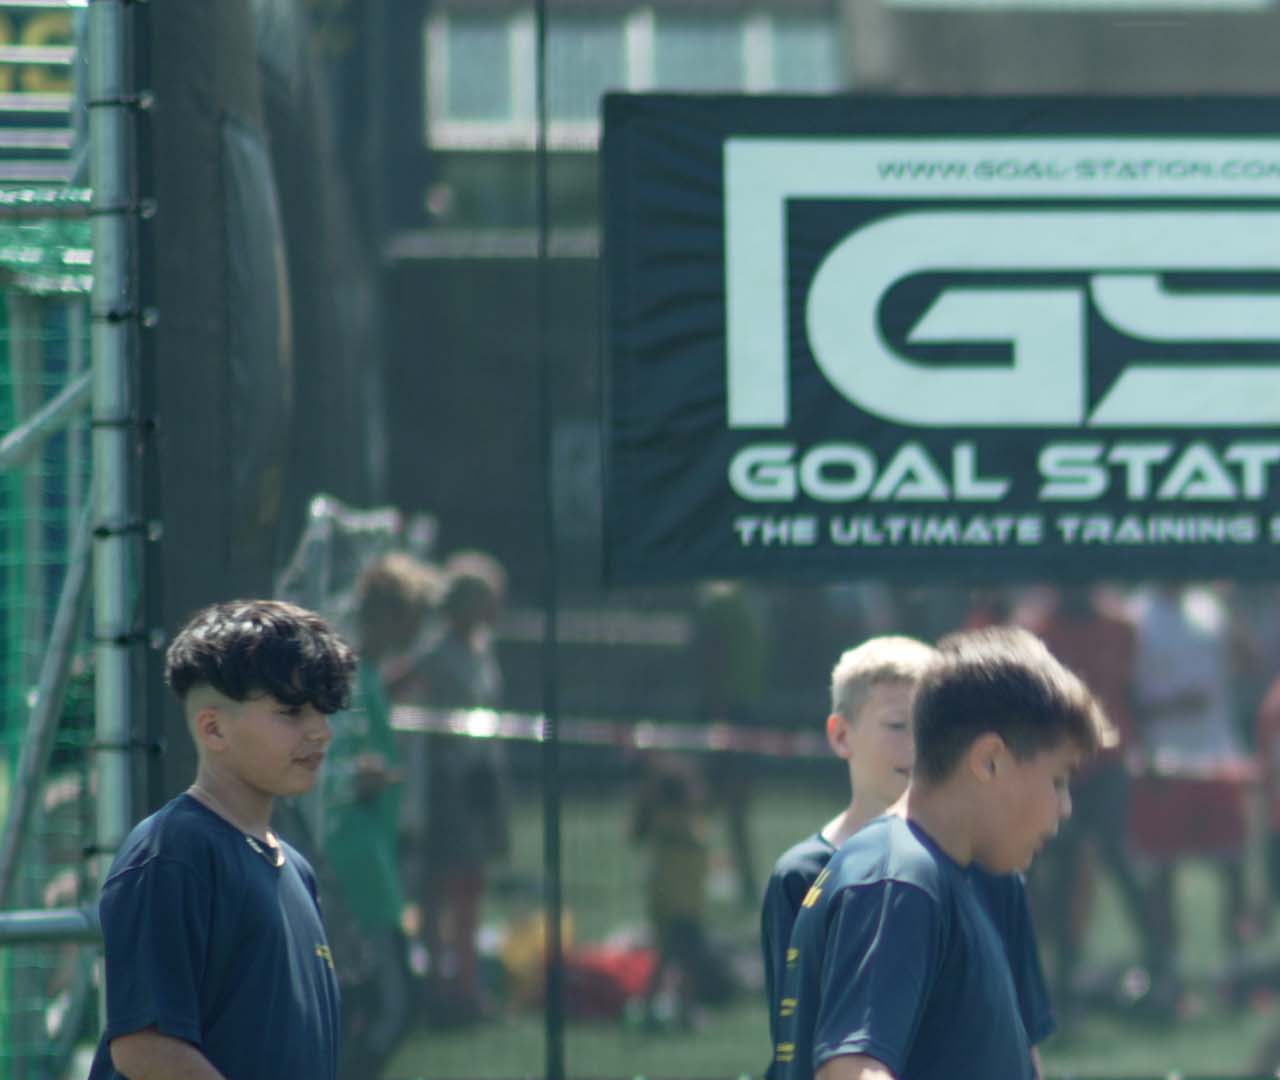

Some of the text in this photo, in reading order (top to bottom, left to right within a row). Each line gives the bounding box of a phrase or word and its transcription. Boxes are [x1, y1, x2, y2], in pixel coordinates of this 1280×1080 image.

[728, 443, 1010, 502] GOAL
[734, 517, 816, 546] THE
[832, 517, 1043, 546] ULTIMATE
[1058, 516, 1256, 544] TRAINING
